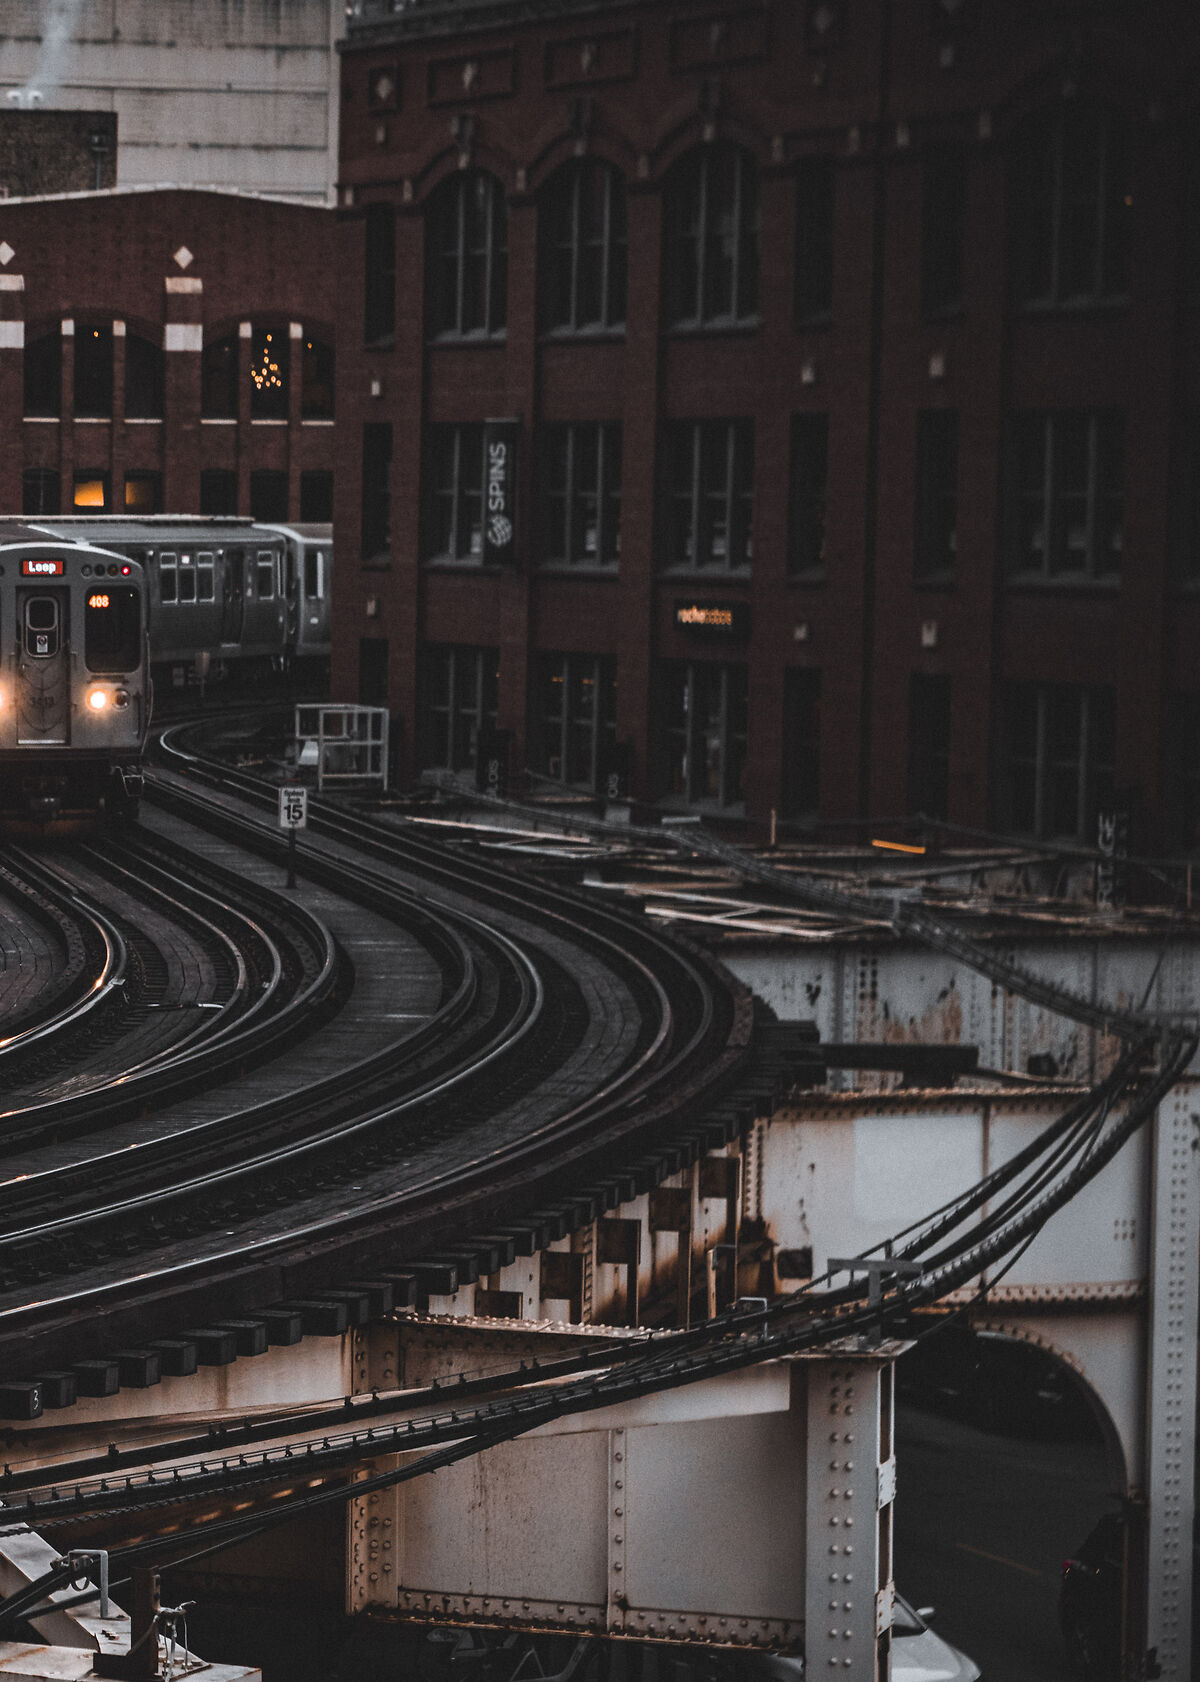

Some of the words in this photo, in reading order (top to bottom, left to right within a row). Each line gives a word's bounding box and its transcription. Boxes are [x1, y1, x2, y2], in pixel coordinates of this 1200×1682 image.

[488, 441, 506, 511] SPINS
[28, 560, 56, 574] Loop
[88, 594, 110, 608] 408
[284, 804, 303, 820] 15
